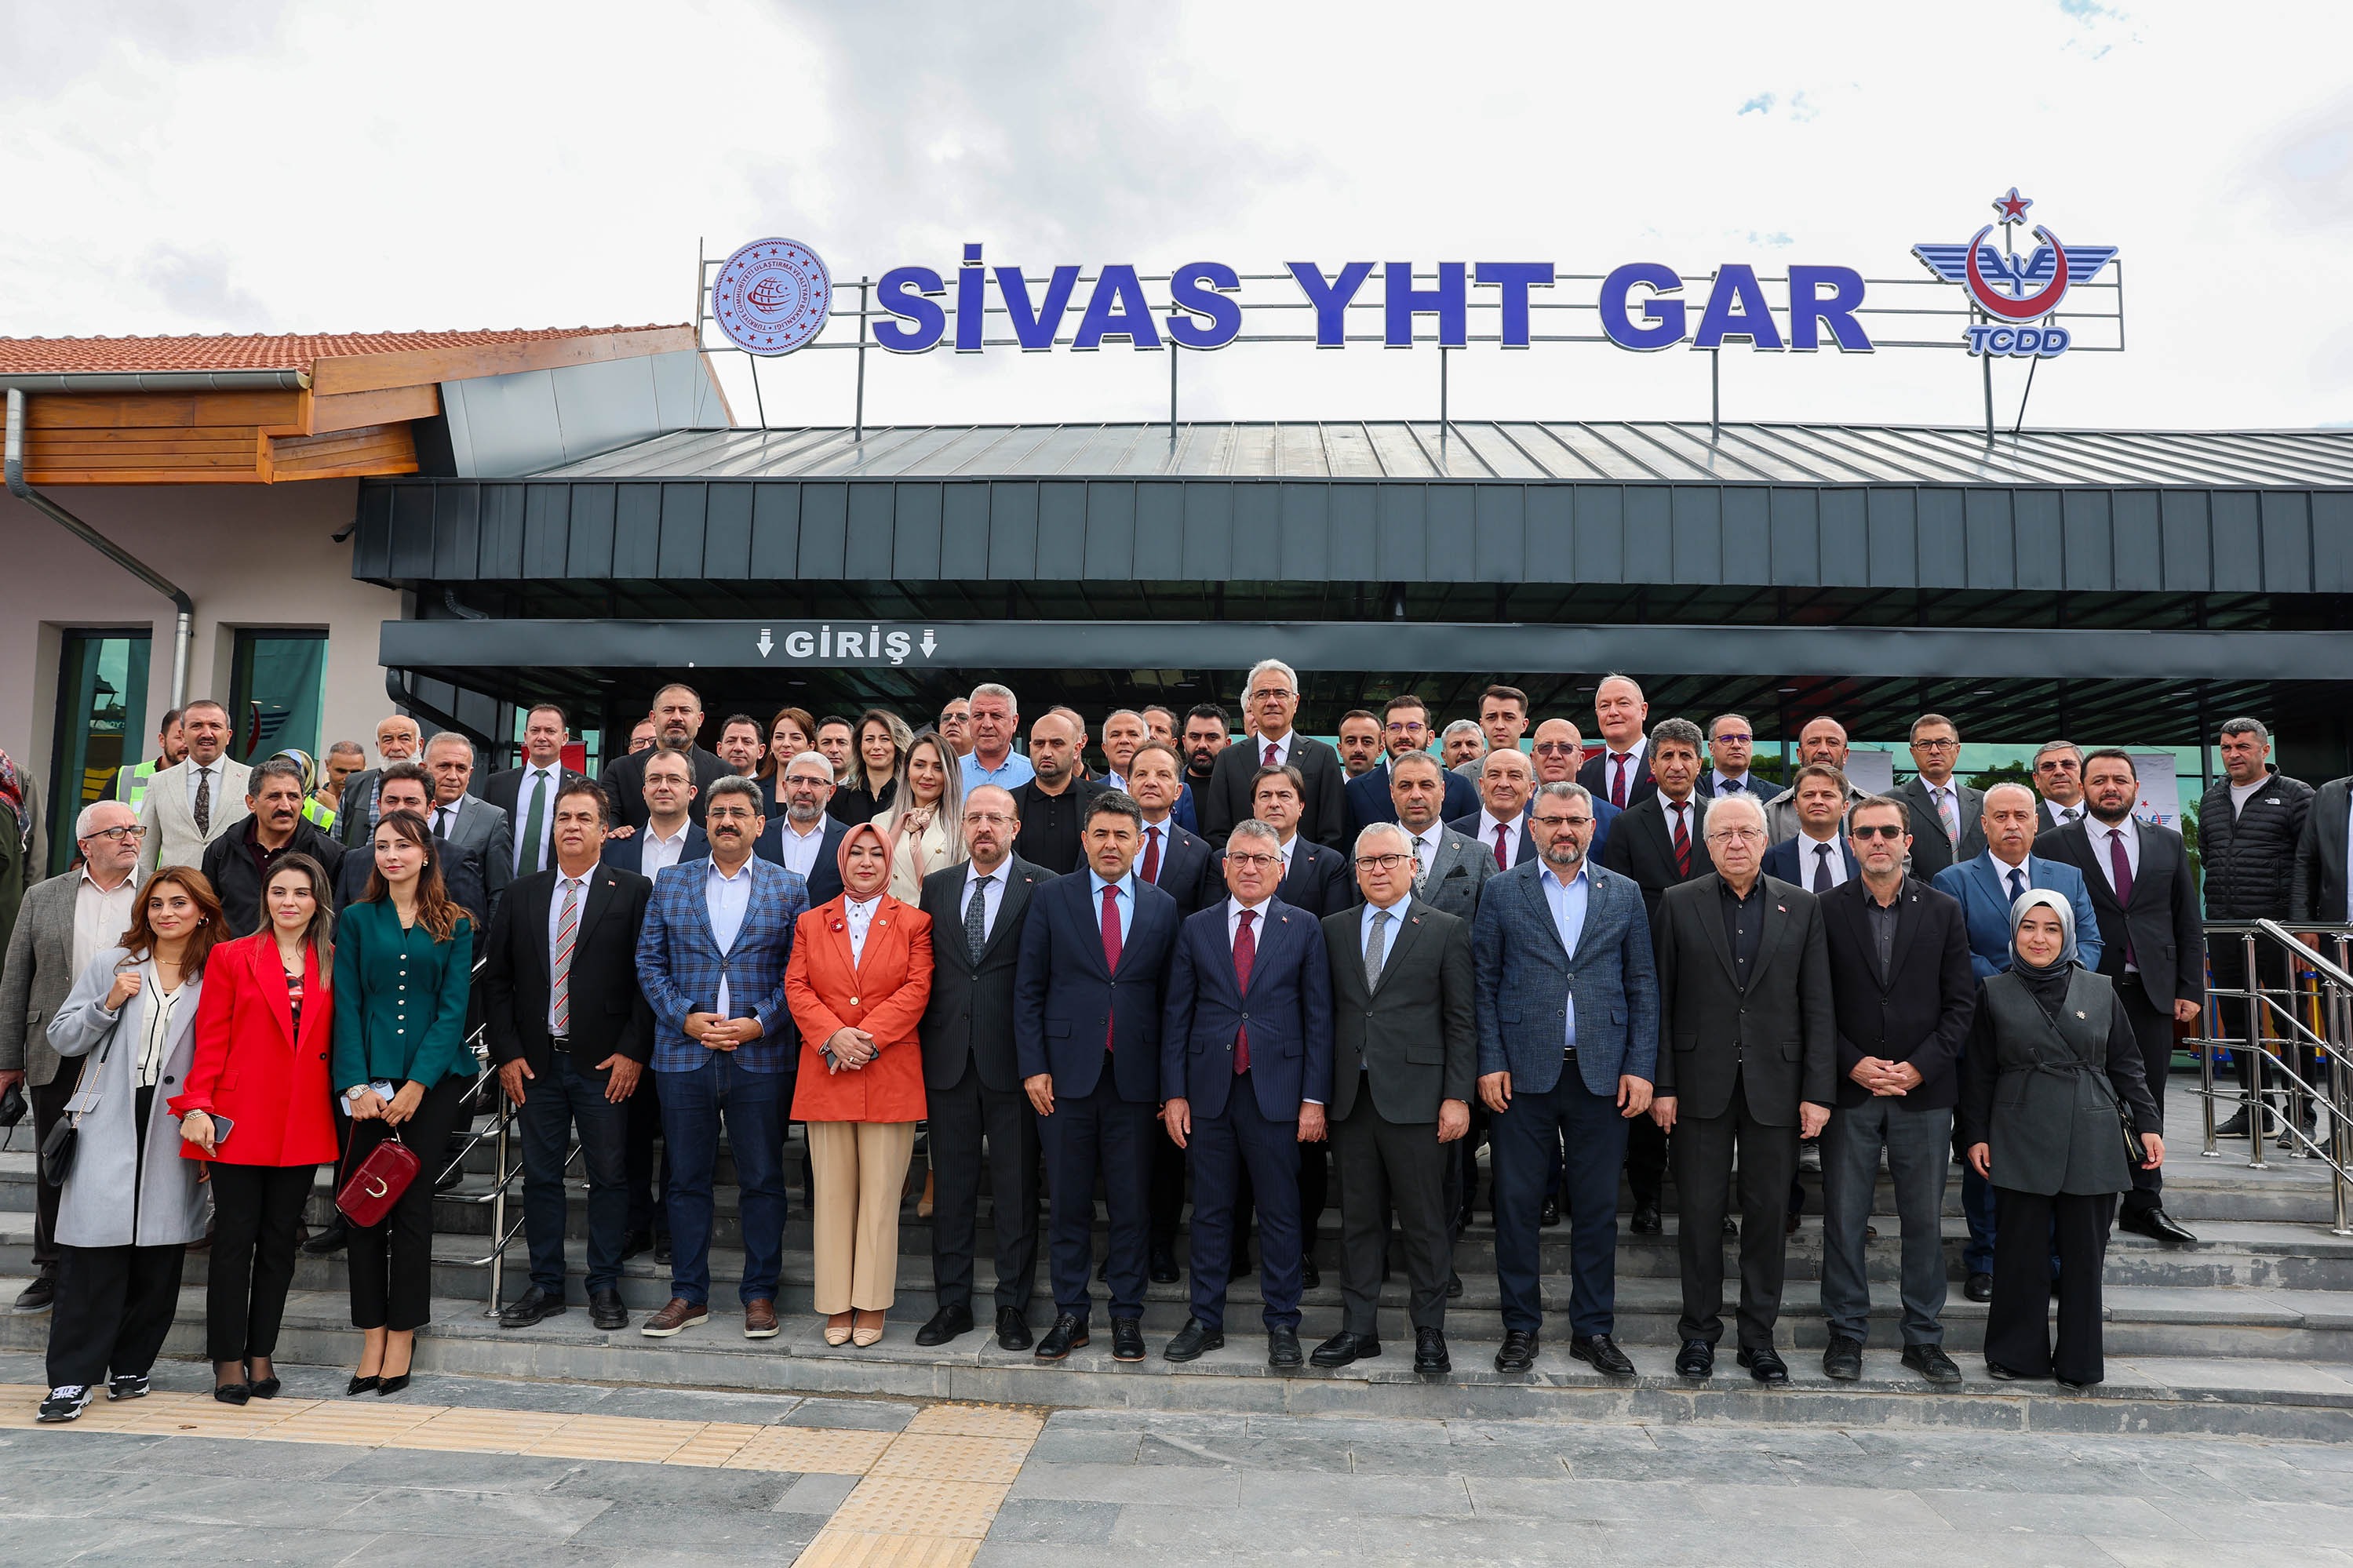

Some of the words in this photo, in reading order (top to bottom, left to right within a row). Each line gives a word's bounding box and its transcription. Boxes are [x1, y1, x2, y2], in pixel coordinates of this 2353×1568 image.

[755, 261, 792, 271] ULAŞTIRMA
[792, 268, 801, 277] VE
[736, 268, 754, 314] CUMHURİYETİ
[798, 278, 808, 304] ALTYAPI
[873, 243, 1242, 351] SİVAS
[1287, 262, 1554, 347] YHT
[1599, 264, 1874, 352] GAR
[741, 313, 767, 330] TÜRKİYE
[774, 303, 805, 330] BAKANLIĞI
[1968, 328, 2069, 353] TCDD
[785, 624, 911, 665] GİRİŞ
